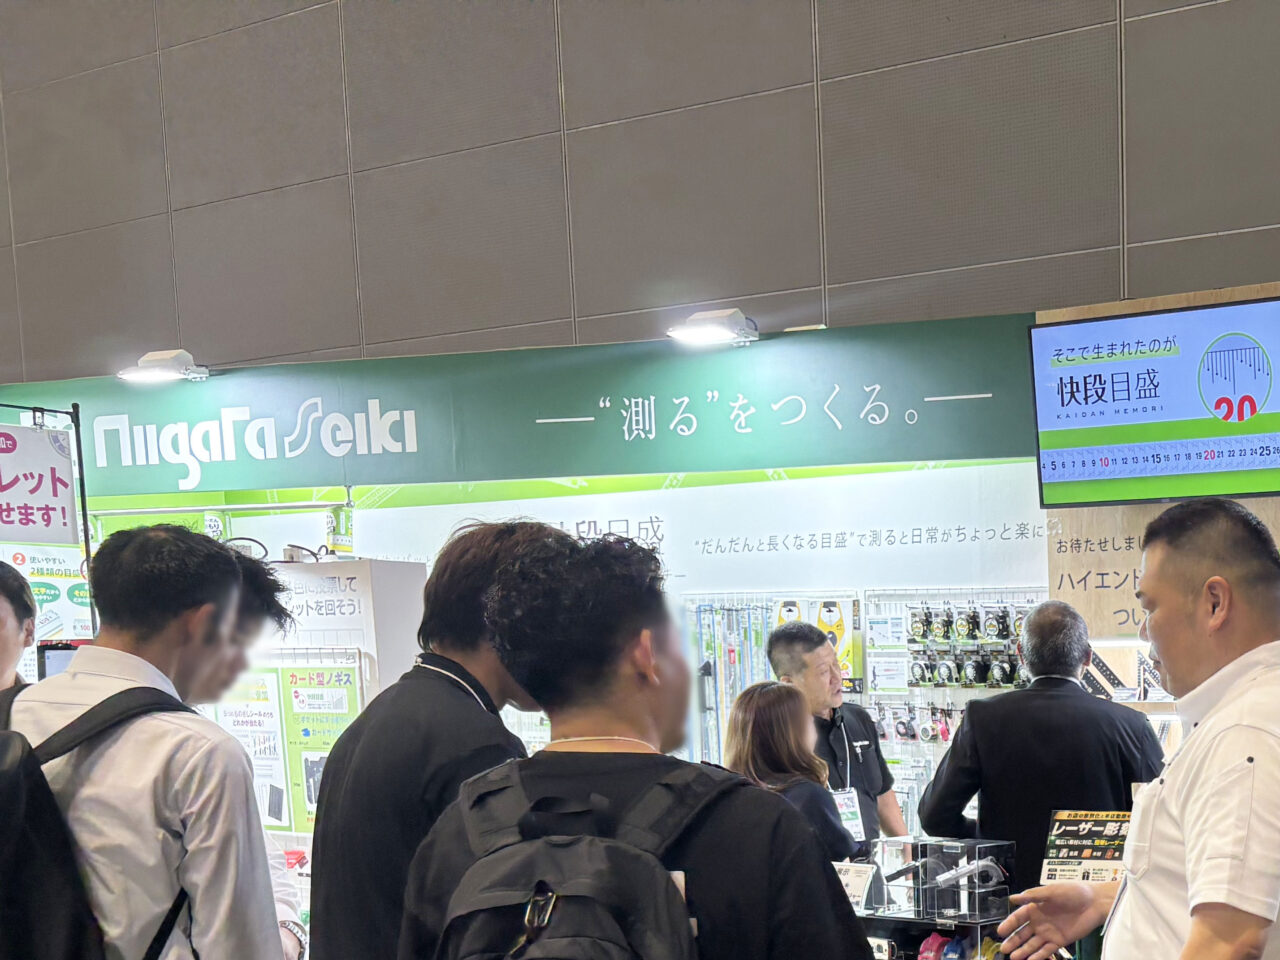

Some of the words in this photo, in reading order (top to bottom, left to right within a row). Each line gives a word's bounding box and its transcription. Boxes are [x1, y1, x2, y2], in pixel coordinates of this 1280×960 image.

[1052, 335, 1177, 363] そこで生まれたのが
[1057, 368, 1160, 407] 快段目盛
[1057, 409, 1105, 420] KAIDAN
[1114, 405, 1164, 415] MEMORI
[1214, 394, 1257, 422] 20
[93, 406, 278, 491] Niigata
[283, 397, 418, 458] Seiki
[1051, 461, 1057, 470] 5
[1092, 459, 1096, 467] 9
[1099, 457, 1110, 467] 10
[1121, 457, 1128, 465] 12
[1131, 456, 1139, 464] 13
[1151, 453, 1162, 464] 15
[1174, 453, 1180, 461] 17
[1203, 449, 1216, 460] 20
[1217, 450, 1224, 458] 21
[1238, 449, 1247, 457] 23
[1249, 448, 1258, 456] 24
[1258, 445, 1271, 457] 25
[1272, 446, 1280, 454] 26
[289, 671, 353, 687] カード型ノギス
